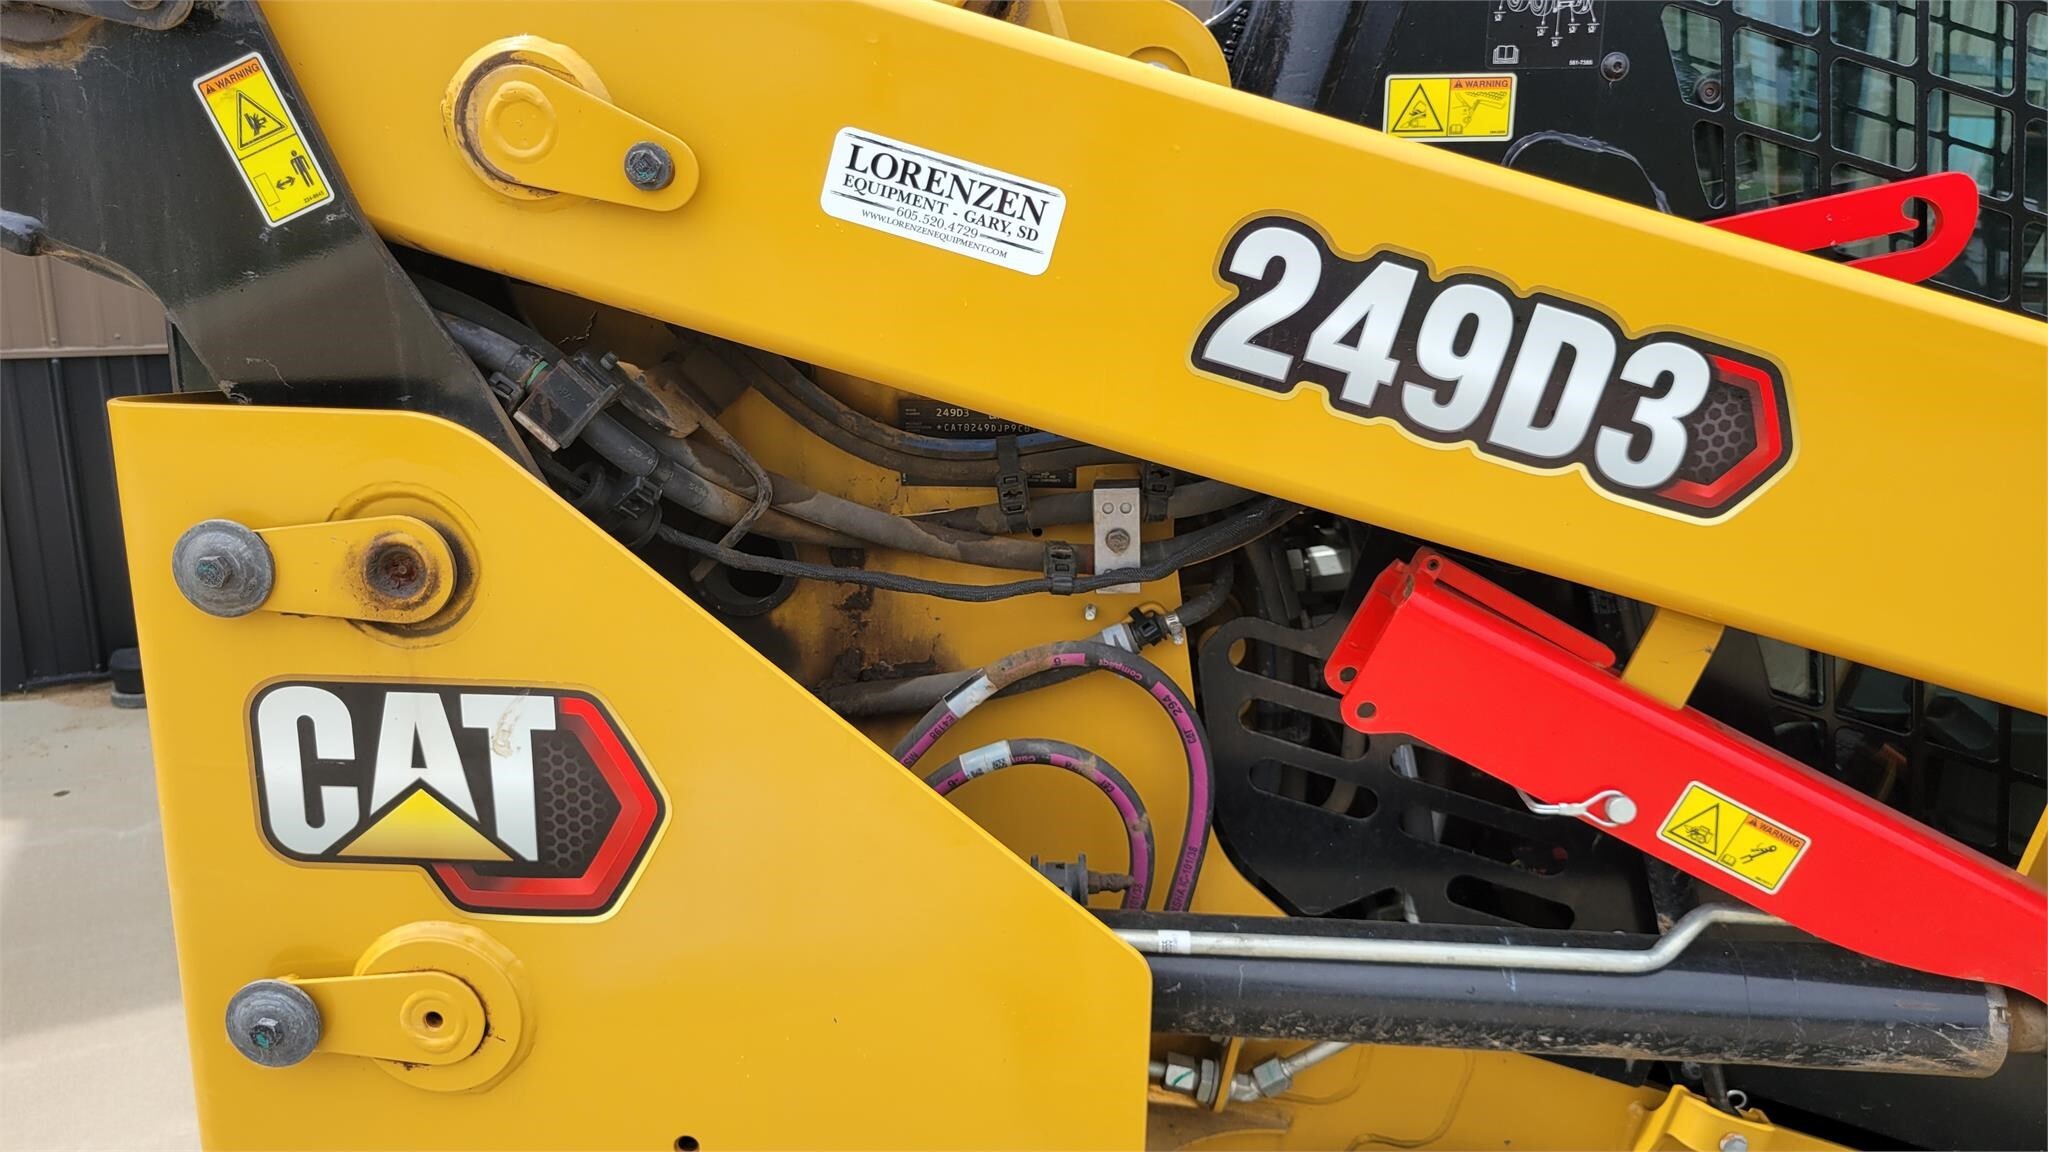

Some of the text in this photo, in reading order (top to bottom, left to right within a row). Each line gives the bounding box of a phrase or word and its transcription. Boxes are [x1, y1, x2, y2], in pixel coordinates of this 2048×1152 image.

[216, 63, 260, 89] WARNING
[1464, 79, 1508, 89] WARNING
[845, 143, 1050, 226] LORENZEN
[843, 173, 949, 215] EQUIPMENT
[963, 209, 1013, 237] GARY,
[1016, 225, 1038, 242] SD
[896, 206, 979, 239] 605.520.4729
[861, 208, 1008, 259] WWW.LORENZENEQUIPMENT.COM
[1203, 226, 1711, 490] 249D3
[936, 408, 970, 417] 249D3
[1099, 657, 1143, 681] Compact
[1162, 694, 1197, 744] CAT 294
[257, 686, 557, 862] CAT
[1100, 780, 1115, 793] CAT
[1759, 823, 1802, 849] WARNING
